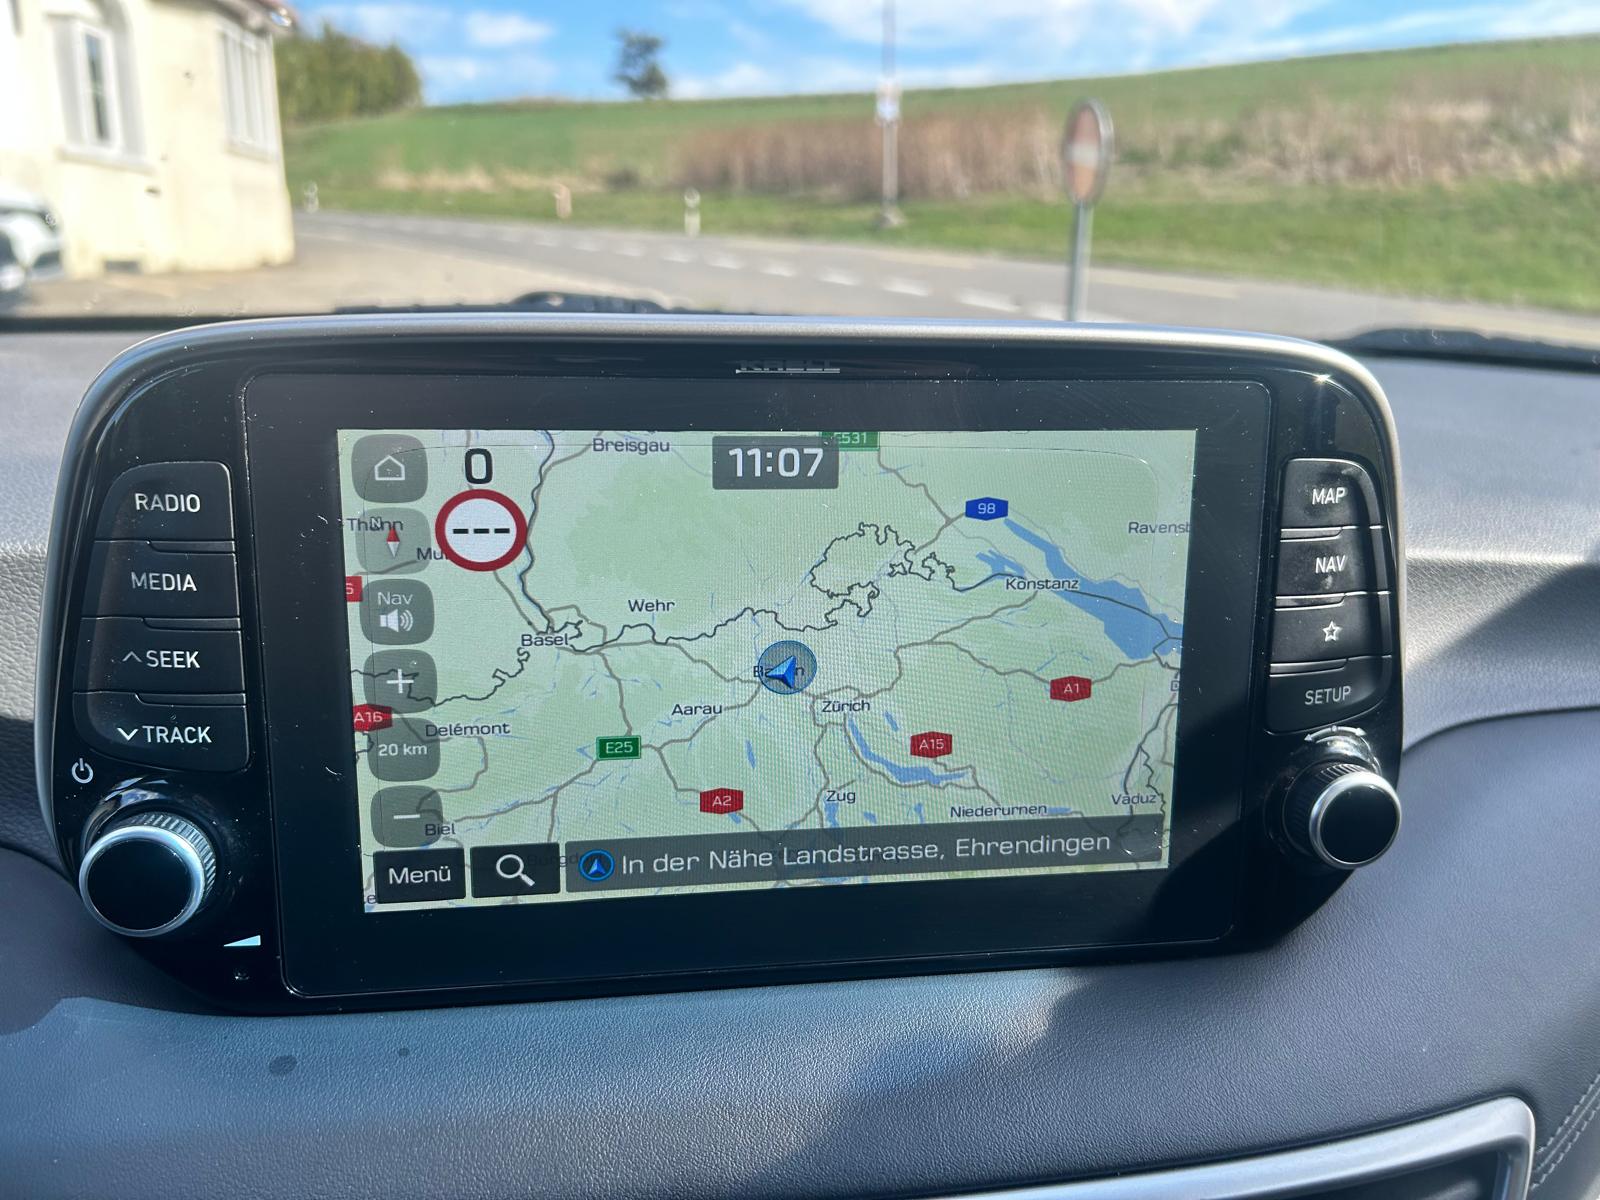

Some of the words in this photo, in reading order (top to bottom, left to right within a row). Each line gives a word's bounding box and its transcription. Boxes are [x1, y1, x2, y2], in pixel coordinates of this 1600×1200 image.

[592, 436, 671, 455] Breisgau
[464, 448, 493, 484] 0
[728, 447, 824, 478] 11:07
[135, 493, 201, 513] RADIO
[1311, 486, 1347, 506] MAP
[977, 502, 997, 516] 98
[1315, 555, 1347, 573] NAV
[131, 572, 197, 592] MEDIA
[1005, 578, 1080, 592] Konstanz
[377, 591, 414, 606] Nav
[628, 598, 676, 613] Wehr
[520, 632, 570, 648] Basel
[146, 650, 201, 669] SEEK
[1063, 682, 1081, 695] A1
[1305, 685, 1352, 705] SETUP
[671, 702, 723, 716] Aarau
[821, 698, 871, 715] Zürich
[354, 711, 384, 723] A16
[142, 725, 213, 744] TRACK
[425, 721, 511, 738] Delémont
[378, 744, 399, 757] 20
[403, 743, 428, 756] km
[605, 741, 633, 753] E25
[919, 737, 945, 751] A15
[713, 795, 733, 807] A2
[827, 790, 857, 805] Zug
[1111, 792, 1158, 806] Vaduz
[950, 803, 1048, 819] Niederurnen
[424, 823, 456, 837] Biel
[621, 855, 645, 875] In
[653, 850, 700, 873] der
[710, 847, 774, 871] Nähe
[783, 841, 946, 867] Landstrasse,
[955, 834, 1112, 862] Ehrendingen
[388, 865, 452, 885] Menü
